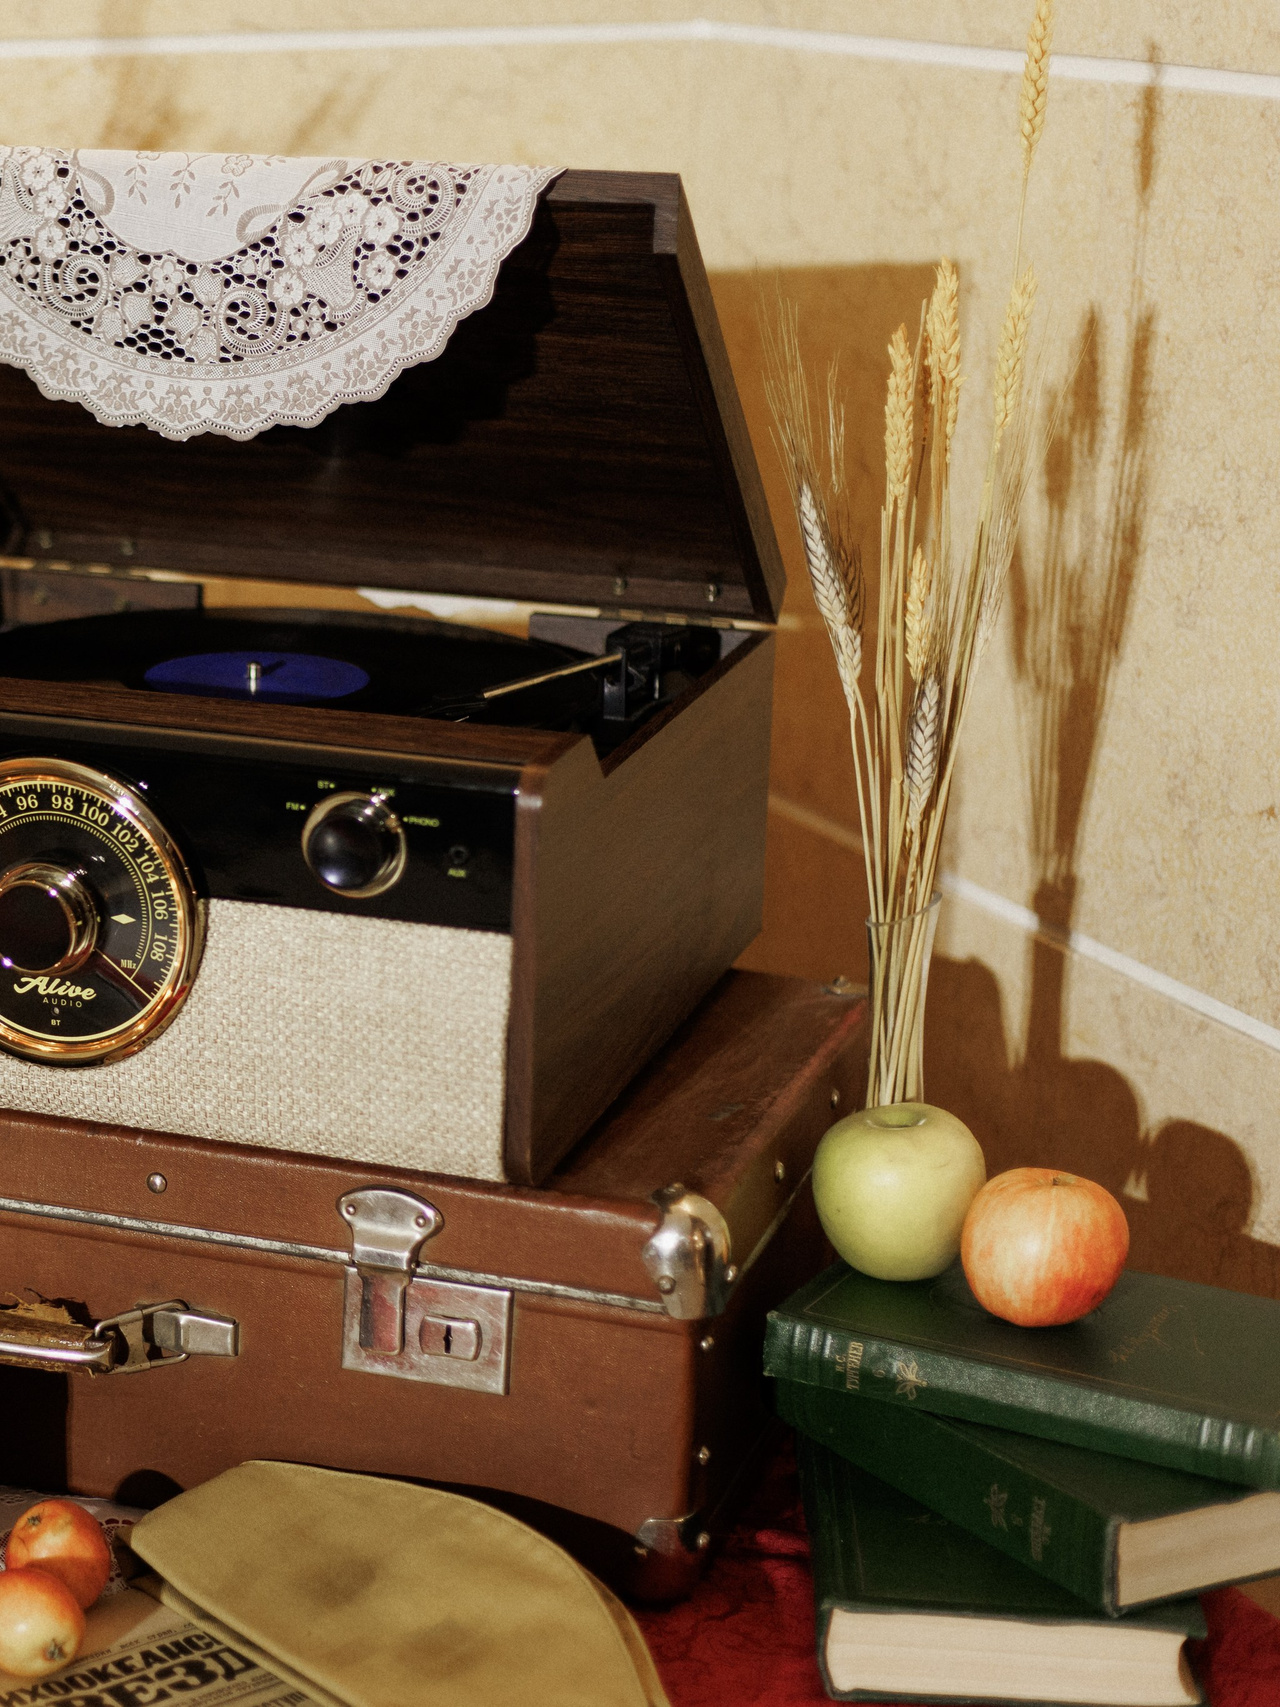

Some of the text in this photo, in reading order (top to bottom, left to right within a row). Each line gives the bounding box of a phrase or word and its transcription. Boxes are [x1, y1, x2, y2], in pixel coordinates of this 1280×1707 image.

[16, 794, 39, 811] 96
[51, 794, 74, 811] 98
[79, 802, 110, 827] 100
[408, 815, 440, 827] PHONO
[110, 822, 140, 853] 102
[135, 853, 160, 884] 104
[447, 868, 467, 878] AUX
[150, 890, 169, 920] 106
[150, 932, 168, 962] 108
[120, 959, 136, 969] MHz
[13, 976, 97, 1000] Alive
[42, 996, 82, 1008] AUDIO
